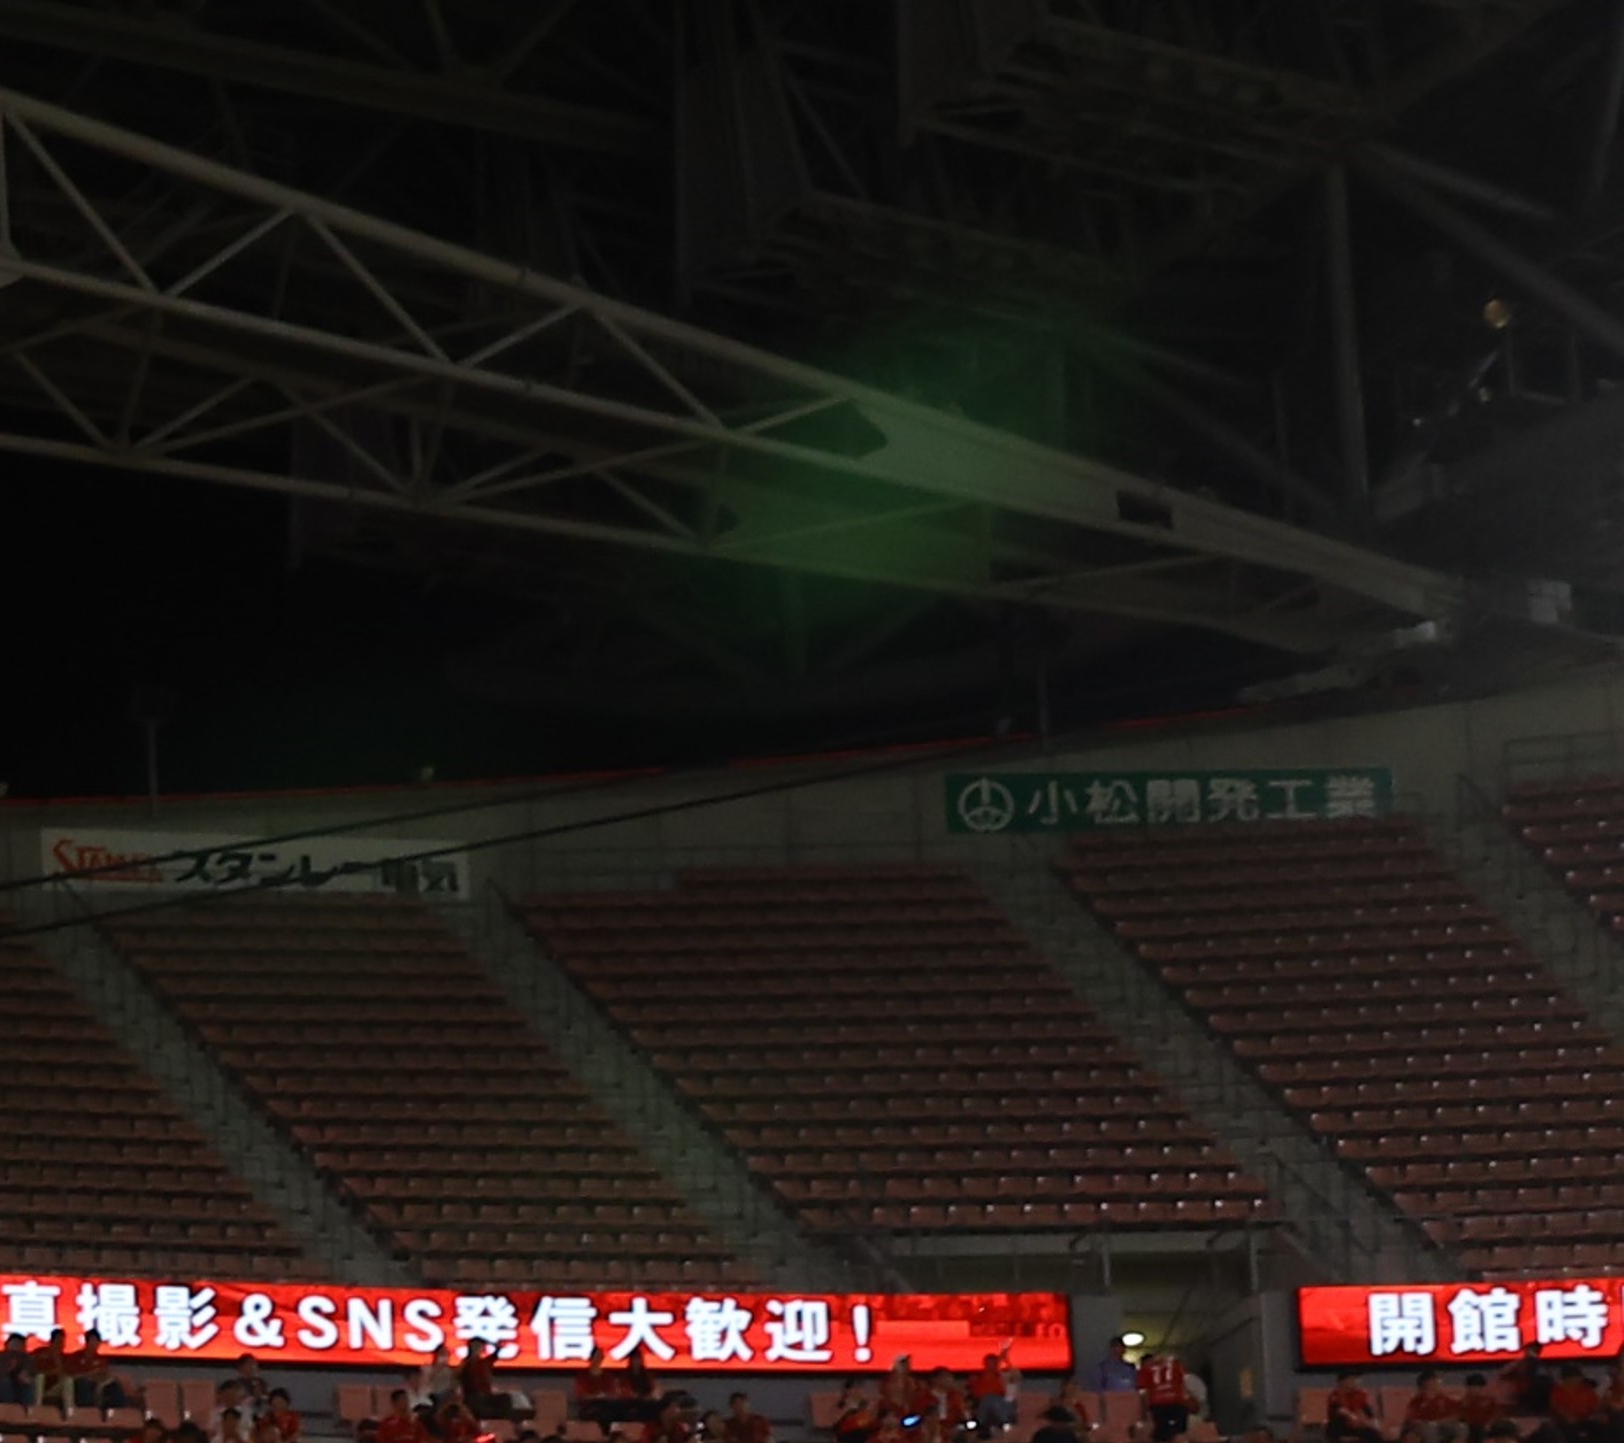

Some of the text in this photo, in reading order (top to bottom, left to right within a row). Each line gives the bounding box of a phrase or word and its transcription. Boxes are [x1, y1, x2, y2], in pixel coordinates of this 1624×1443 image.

[1027, 775, 1379, 823] 小松開発工業
